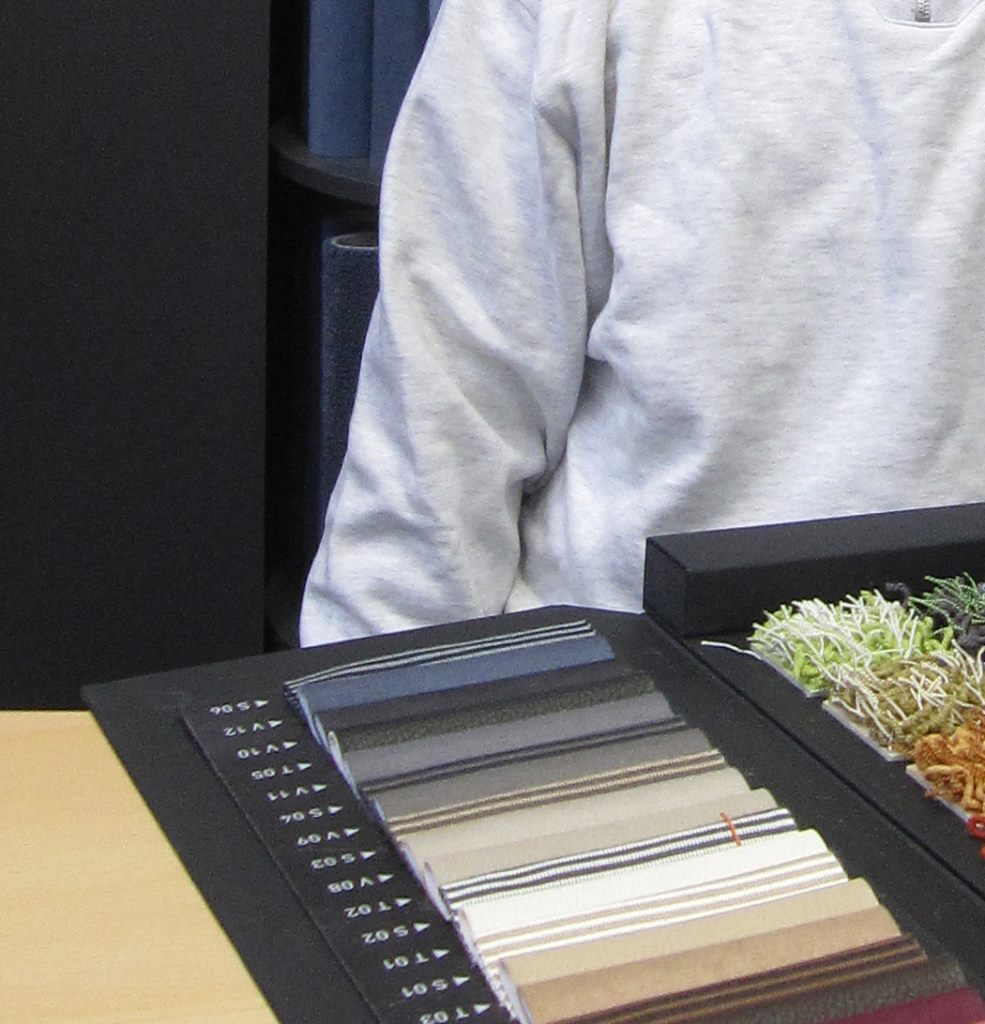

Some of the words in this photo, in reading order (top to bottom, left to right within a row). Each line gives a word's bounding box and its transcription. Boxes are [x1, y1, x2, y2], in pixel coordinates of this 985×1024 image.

[236, 701, 250, 711] S
[253, 723, 265, 732] V
[266, 744, 279, 754] V
[282, 765, 294, 775] T
[296, 787, 309, 797] V
[308, 808, 323, 818] S
[327, 832, 340, 841] V
[341, 853, 356, 864] S
[360, 877, 374, 888] V
[378, 901, 392, 912] T
[393, 925, 409, 937] S
[415, 952, 429, 964] T
[432, 979, 449, 991] S
[455, 1007, 469, 1020] T
